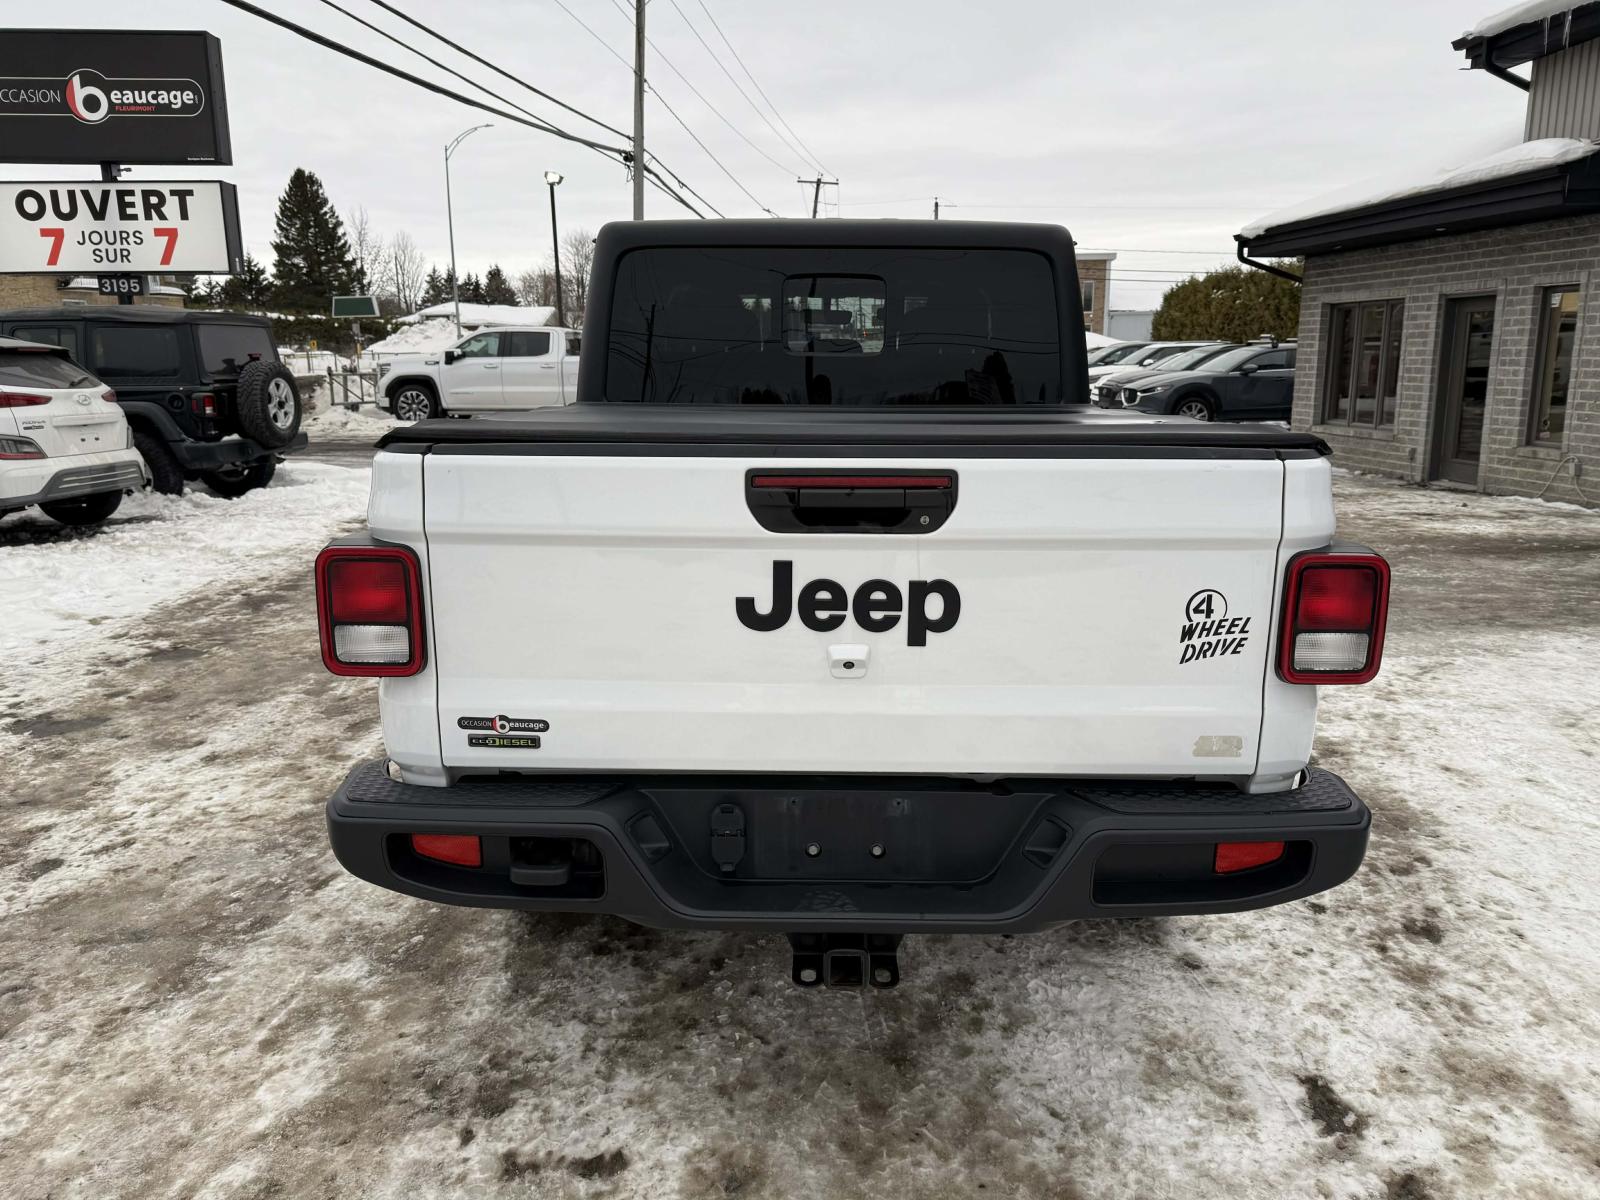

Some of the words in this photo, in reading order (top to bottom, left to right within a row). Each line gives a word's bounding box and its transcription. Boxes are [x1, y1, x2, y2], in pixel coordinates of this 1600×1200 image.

[0, 89, 61, 103] CCASION
[15, 189, 194, 222] OUVERT
[39, 227, 65, 266] 7
[76, 230, 144, 246] JOURS
[153, 227, 179, 266] 7
[92, 248, 132, 264] SUR
[101, 278, 140, 293] 3195
[735, 560, 961, 646] Jeep
[1192, 594, 1214, 619] 4
[1179, 617, 1252, 643] WHEEL
[1179, 637, 1249, 664] DRIVE
